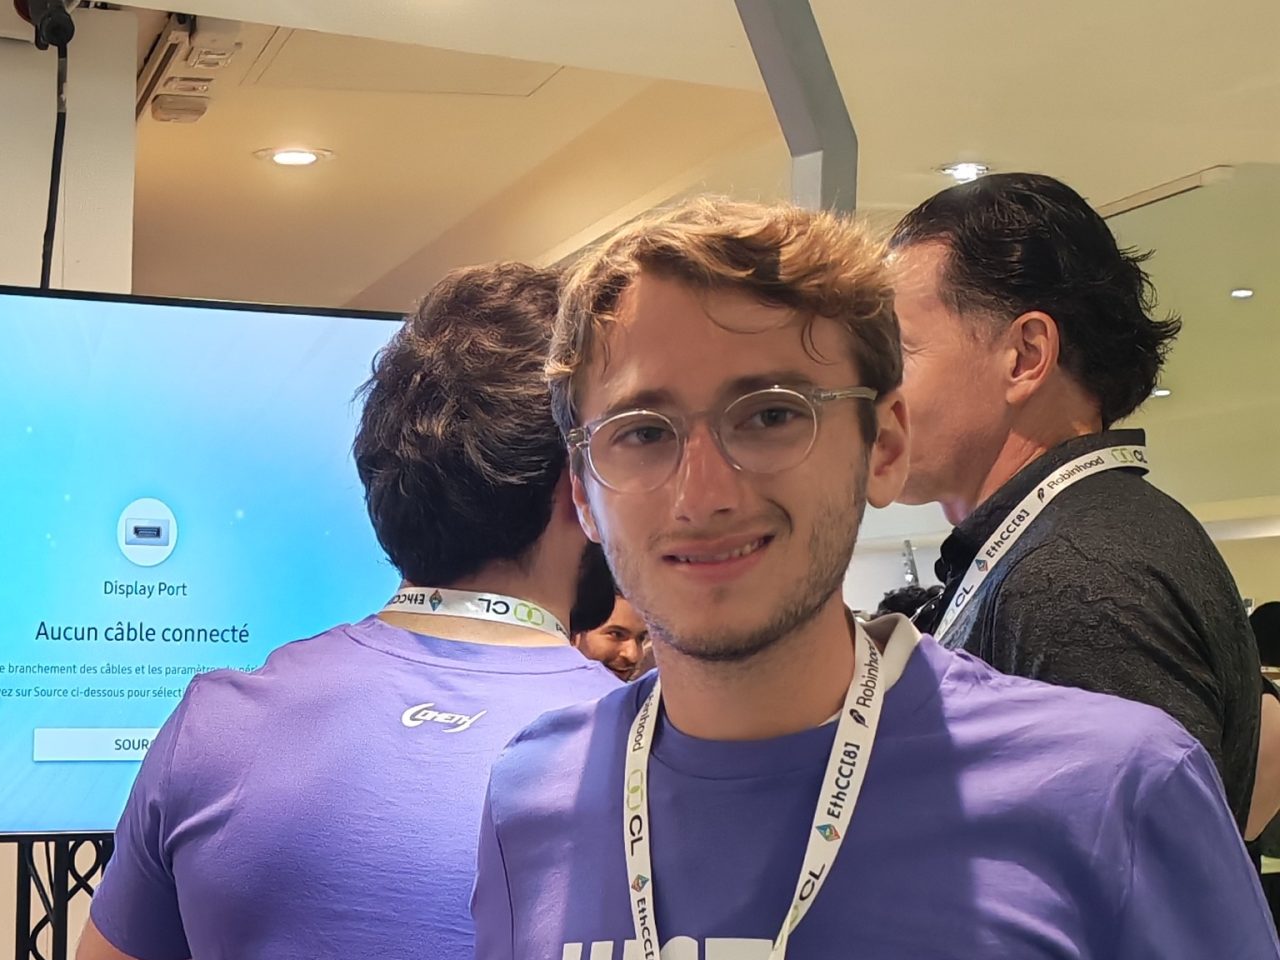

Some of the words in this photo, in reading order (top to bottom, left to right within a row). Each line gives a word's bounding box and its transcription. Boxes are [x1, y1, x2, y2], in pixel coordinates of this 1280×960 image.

[1046, 455, 1105, 490] Robinhood
[103, 580, 155, 598] Display
[158, 582, 188, 597] Port
[954, 583, 975, 609] CL
[477, 598, 511, 615] CL
[35, 621, 98, 642] Aucun
[104, 621, 156, 643] câble
[161, 623, 250, 644] connecté
[8, 663, 77, 675] branchement
[80, 663, 97, 675] des
[100, 662, 133, 675] câbles
[135, 664, 146, 675] et
[148, 664, 163, 676] les
[15, 689, 32, 698] sur
[34, 686, 68, 698] Source
[70, 686, 124, 698] ci-dessous
[127, 689, 151, 701] pour
[827, 742, 860, 820] EthCC[8]
[629, 814, 644, 857] CL
[799, 863, 826, 901] CL
